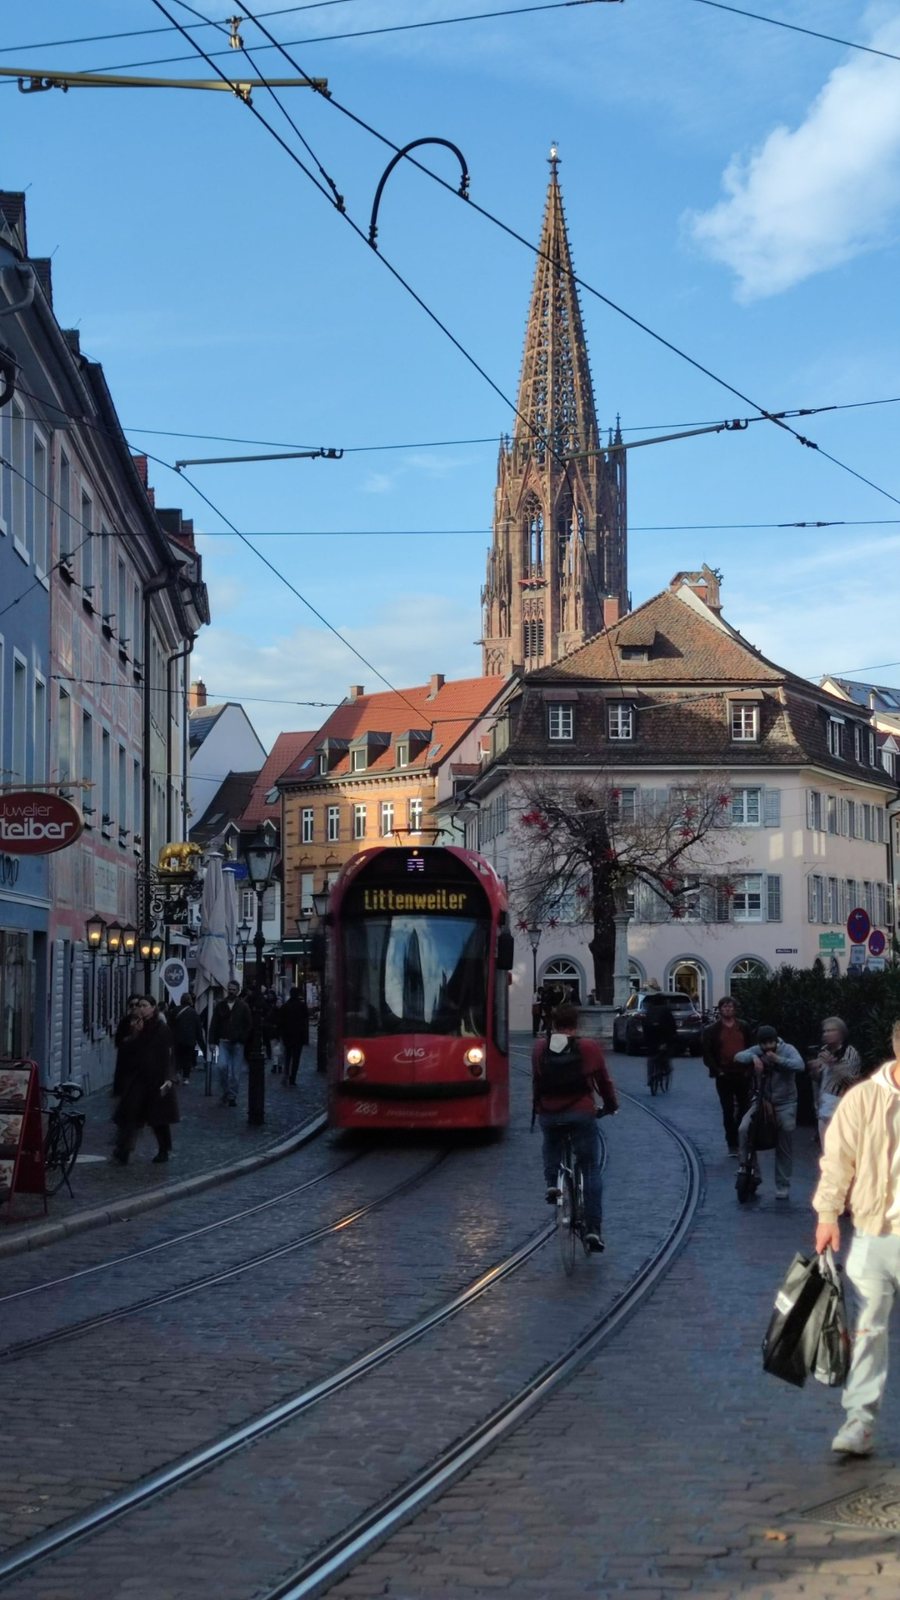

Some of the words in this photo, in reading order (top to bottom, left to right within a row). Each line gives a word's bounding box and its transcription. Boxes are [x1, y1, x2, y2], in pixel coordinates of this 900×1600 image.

[0, 803, 53, 817] Juwelier
[0, 817, 73, 840] teiber
[364, 889, 467, 910] Littenweiler
[404, 1047, 425, 1057] VAG
